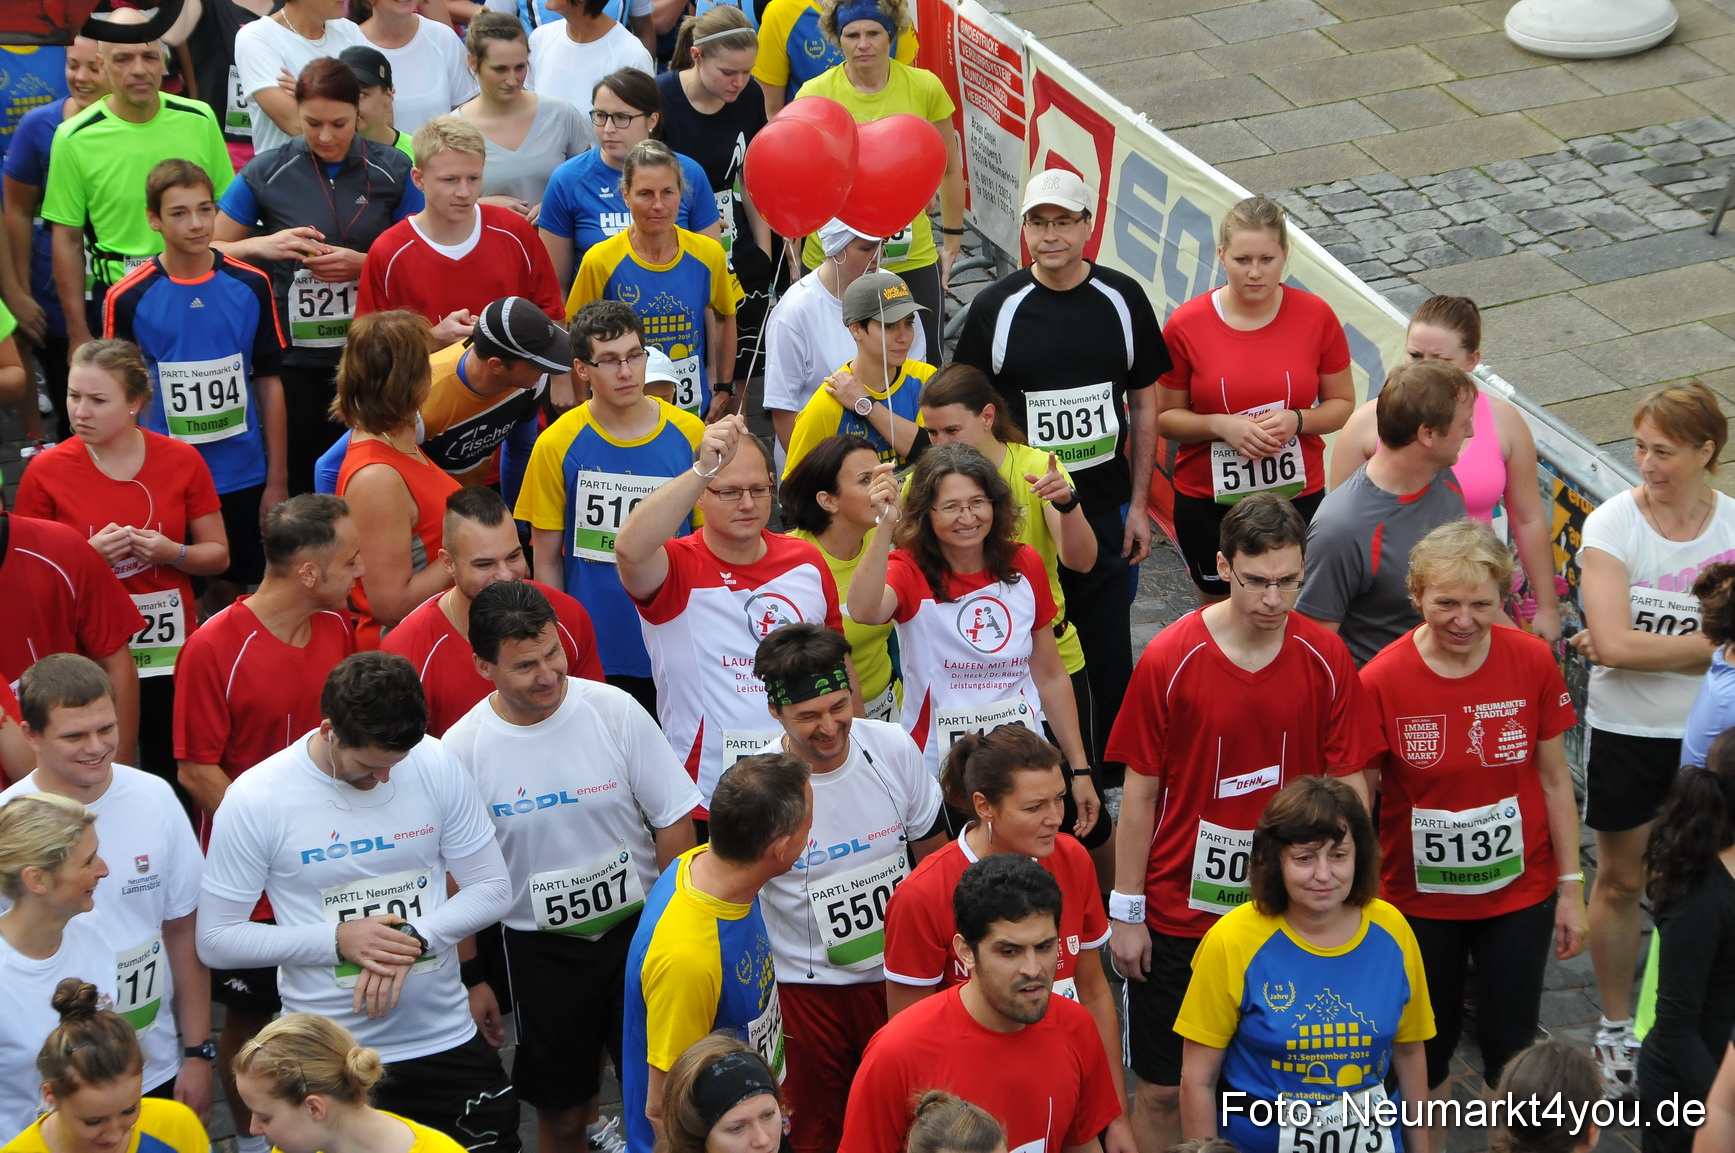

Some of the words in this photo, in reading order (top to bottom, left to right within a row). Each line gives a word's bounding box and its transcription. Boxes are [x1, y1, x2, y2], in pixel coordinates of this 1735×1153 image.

[298, 286, 358, 318] 521
[161, 370, 189, 378] PARTL
[191, 366, 232, 378] Neumarkt
[170, 375, 240, 413] 5194
[1028, 399, 1057, 407] PARTL
[1059, 394, 1100, 406] Neumarkt
[185, 417, 229, 432] Thomas
[1037, 404, 1108, 442] 5031
[460, 419, 517, 456] Fischer
[1056, 444, 1096, 460] Roland
[1222, 451, 1296, 491] 5106
[580, 479, 613, 491] PARTL
[1631, 595, 1665, 609] PARTL
[129, 612, 175, 644] 25
[1632, 610, 1699, 636] 502
[944, 659, 984, 670] LAUFEN
[938, 716, 973, 727] PARTL
[975, 708, 1017, 723] Neumarkt
[1474, 708, 1519, 720] STADTLAUF
[1403, 730, 1440, 740] WIEDER
[1404, 722, 1438, 732] IMMER
[726, 739, 761, 749] PARTL
[1406, 740, 1438, 752] NEU
[1407, 752, 1438, 760] MARKT
[577, 779, 618, 796] energie
[1236, 775, 1263, 790] DEHN
[1414, 817, 1451, 829] PARTL
[1453, 812, 1501, 829] Neumarkt
[394, 823, 434, 841] energie
[867, 820, 902, 841] energie
[1200, 830, 1235, 847] PARTL
[1425, 824, 1513, 863] 5132
[1205, 847, 1249, 883] 50
[532, 880, 570, 893] PARTL
[571, 861, 618, 886] Neumarkt
[811, 884, 849, 902] PARTL
[850, 865, 897, 890] Neumarkt
[1440, 867, 1500, 883] Theresia
[324, 891, 364, 906] PARTL
[366, 881, 415, 899] Neumarkt
[545, 868, 628, 926] 5507
[827, 875, 904, 939] 550
[117, 950, 150, 969] eumarkt
[116, 960, 157, 1006] 17
[1269, 993, 1289, 1001] Jahre
[1350, 1051, 1370, 1060] 2014
[1293, 1118, 1384, 1153] 5073
